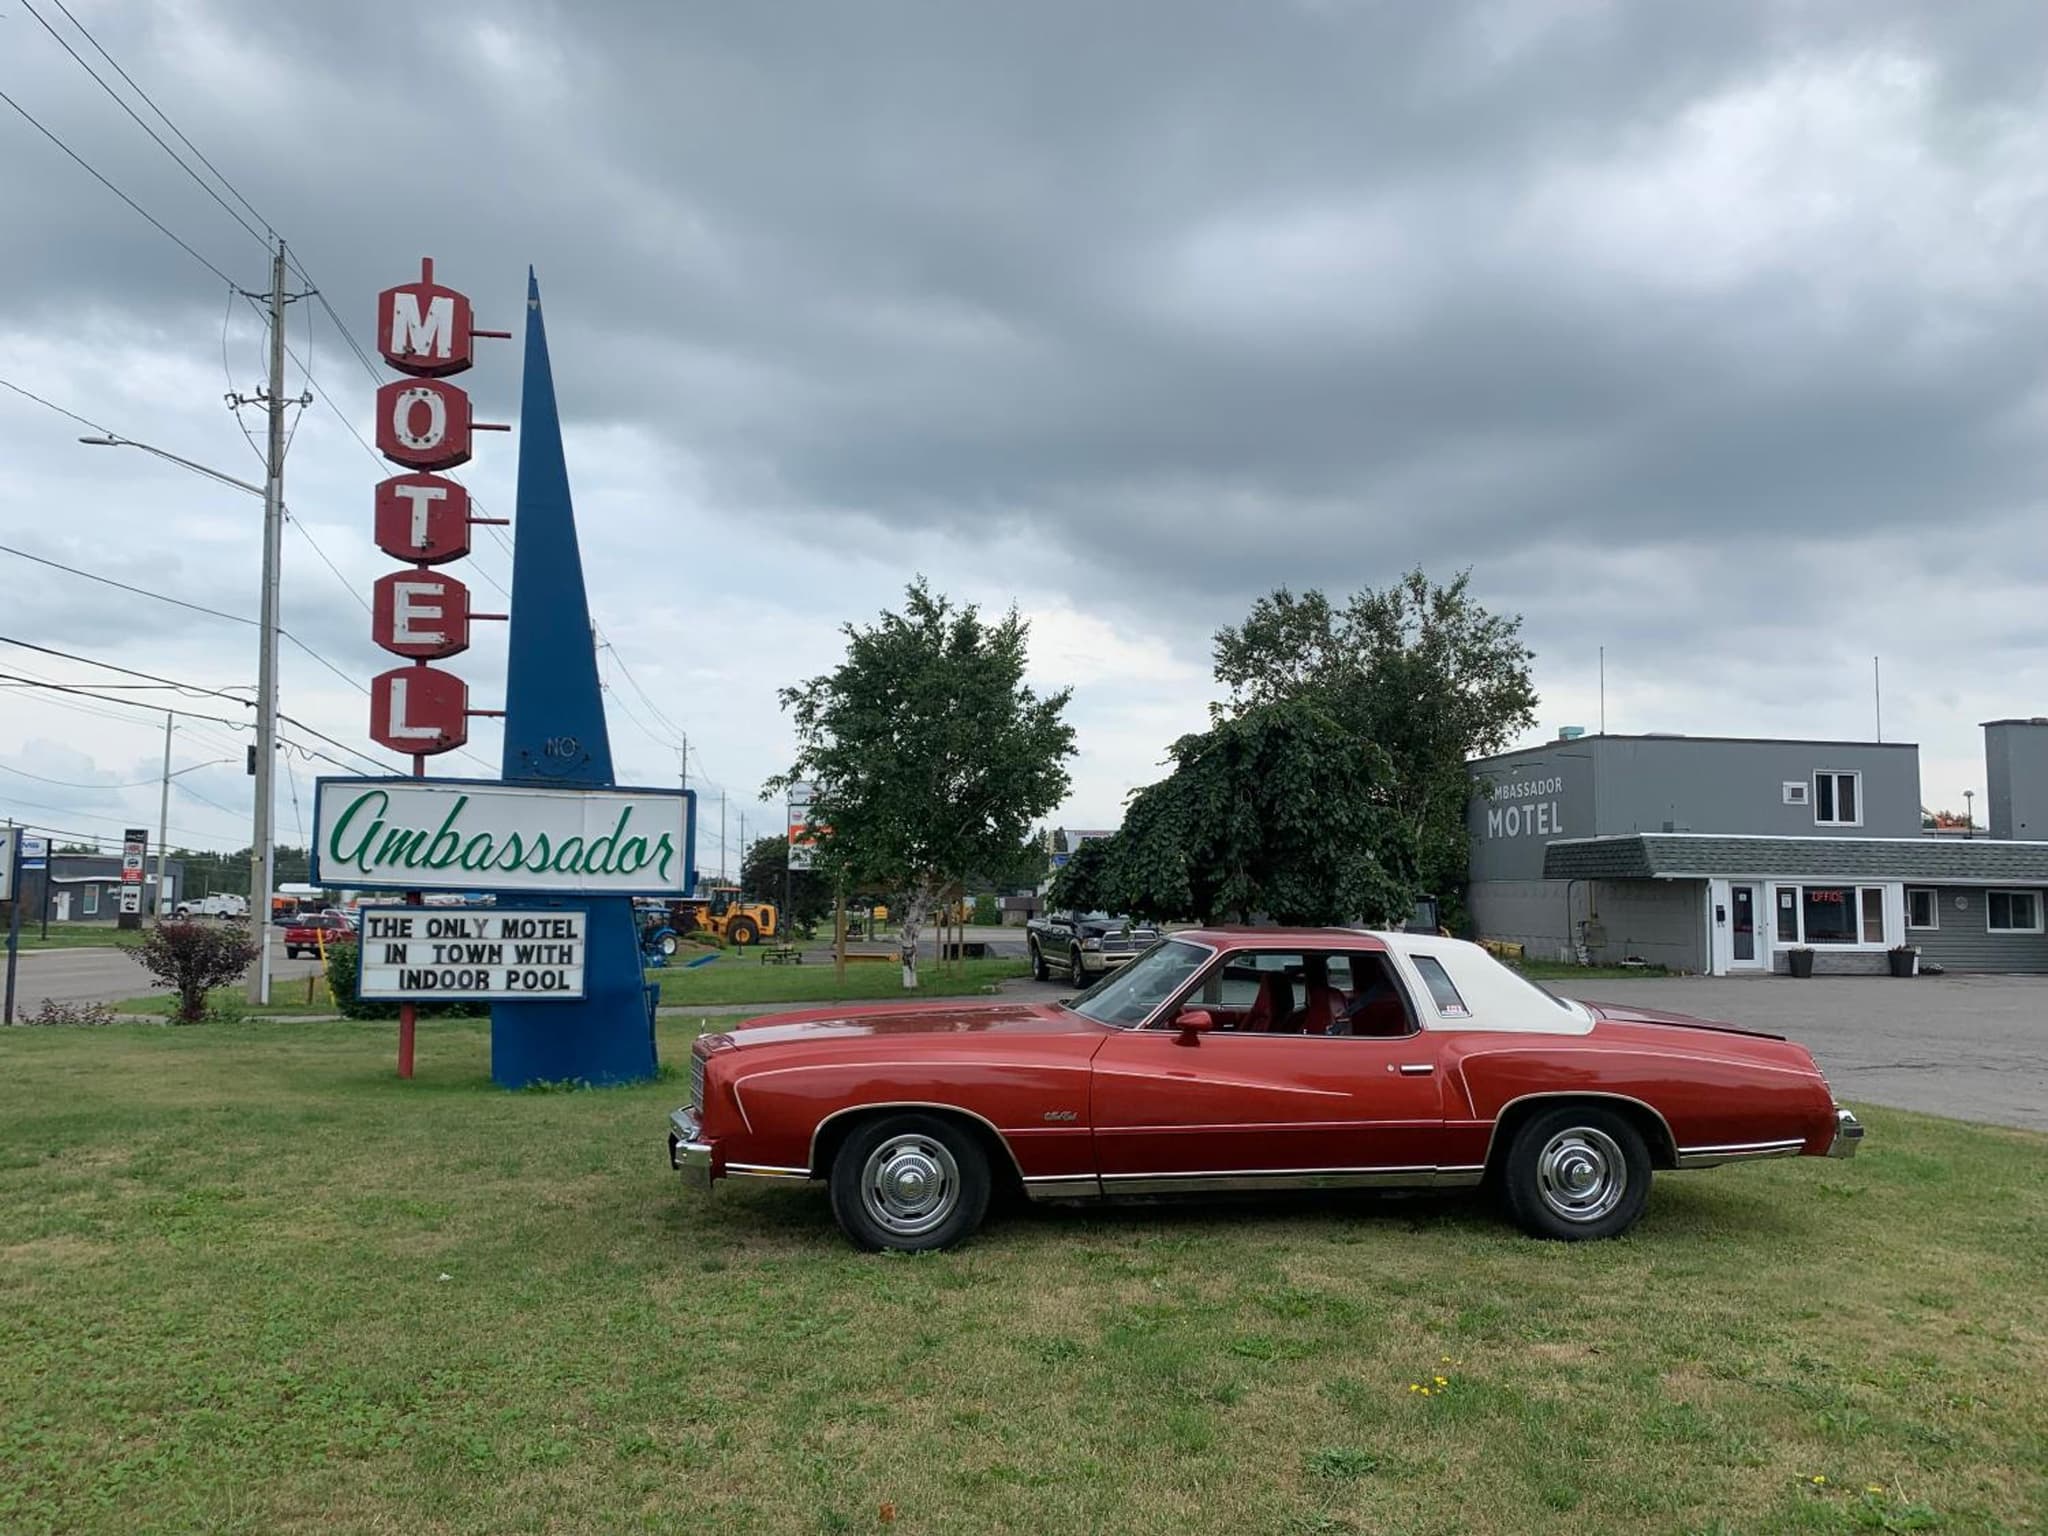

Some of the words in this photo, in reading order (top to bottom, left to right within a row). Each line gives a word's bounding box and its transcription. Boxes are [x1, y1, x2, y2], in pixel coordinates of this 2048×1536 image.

[389, 292, 455, 739] MOTEL
[547, 736, 576, 757] NO
[1488, 801, 1563, 838] MOTEL
[330, 790, 675, 881] Ambassador
[368, 918, 413, 938] THE
[426, 918, 489, 938] ONLY
[502, 919, 578, 938] MOTEL
[385, 944, 407, 964] IN
[432, 944, 503, 964] TOWN
[515, 944, 573, 964] WITH
[399, 969, 490, 990] INDOOR
[505, 970, 570, 990] POOL
